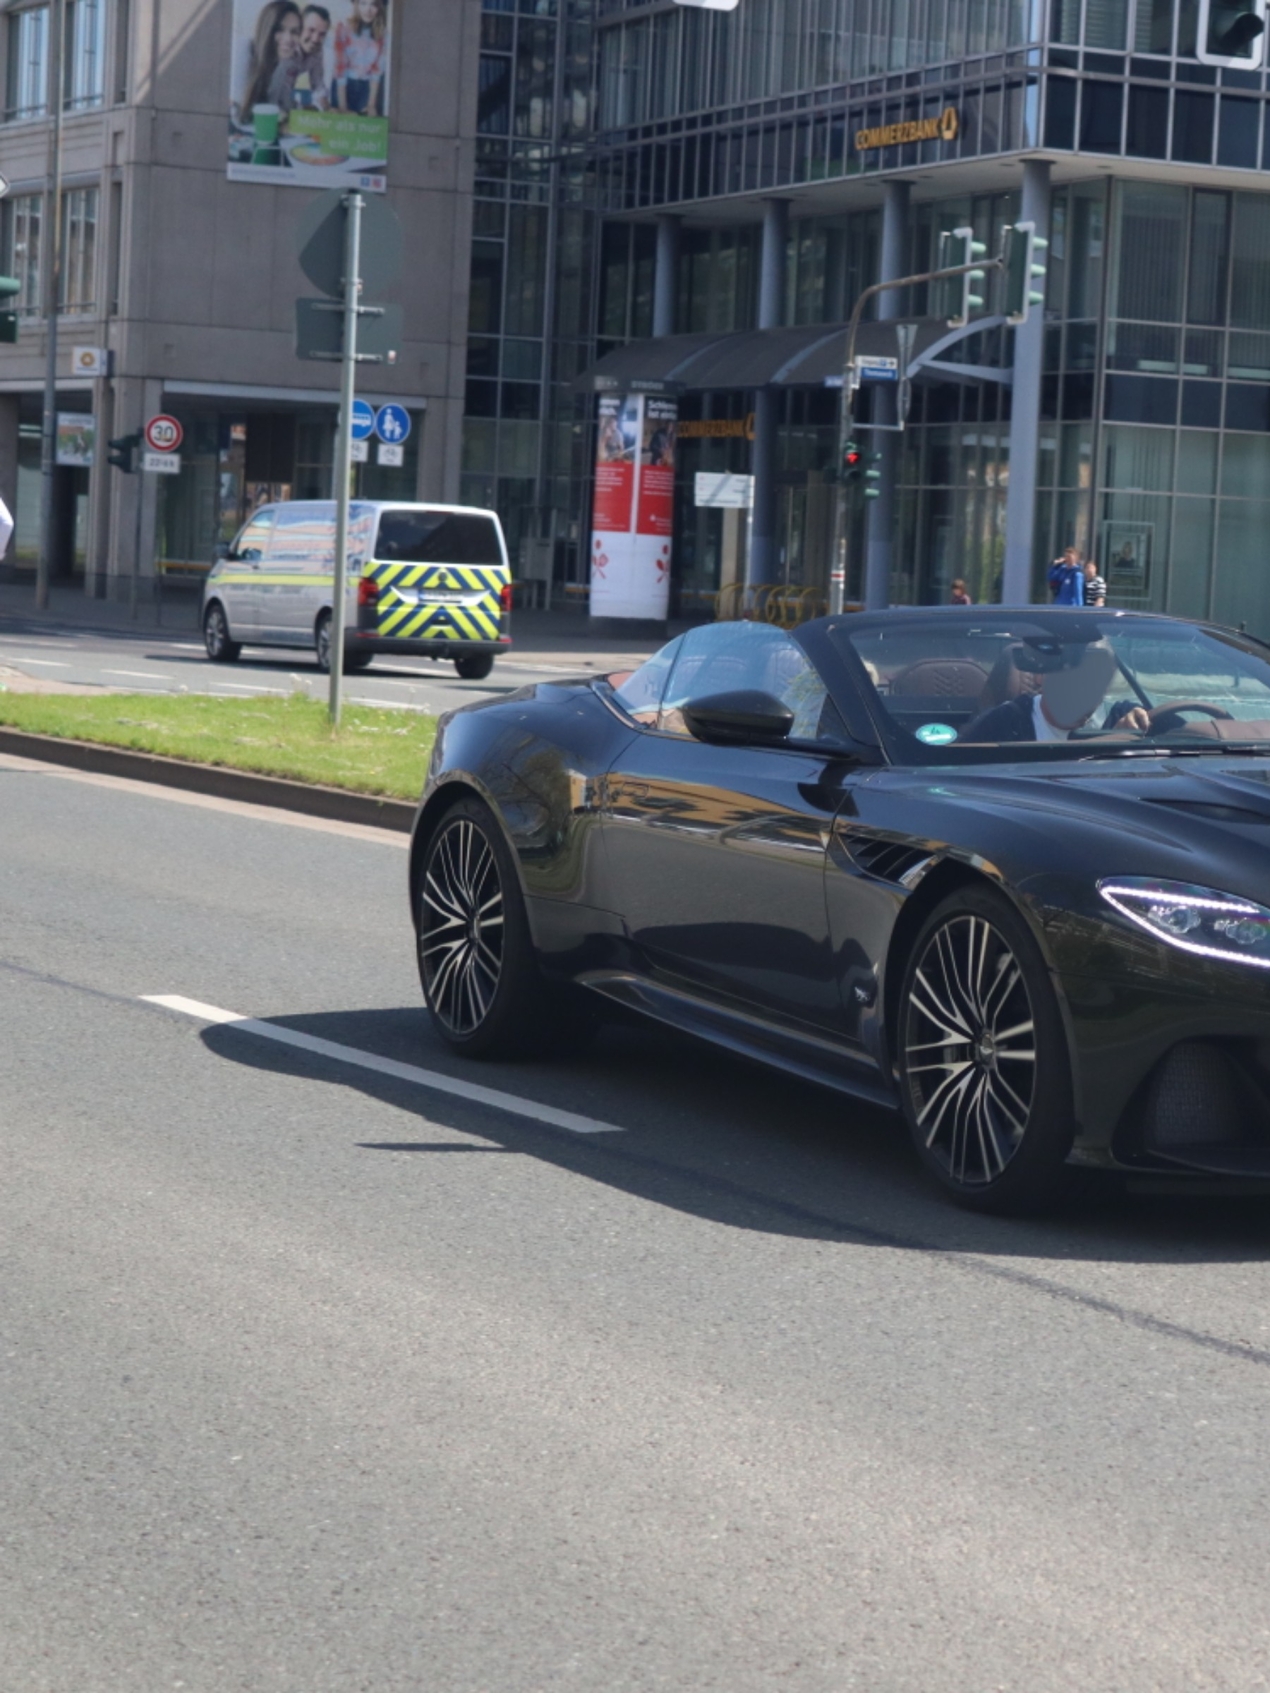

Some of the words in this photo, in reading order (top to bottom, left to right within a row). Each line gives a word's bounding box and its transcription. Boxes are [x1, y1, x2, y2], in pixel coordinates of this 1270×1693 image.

[297, 114, 333, 129] Mehr
[336, 119, 355, 132] als
[855, 117, 940, 150] COMMERZBANK
[153, 424, 174, 443] 30
